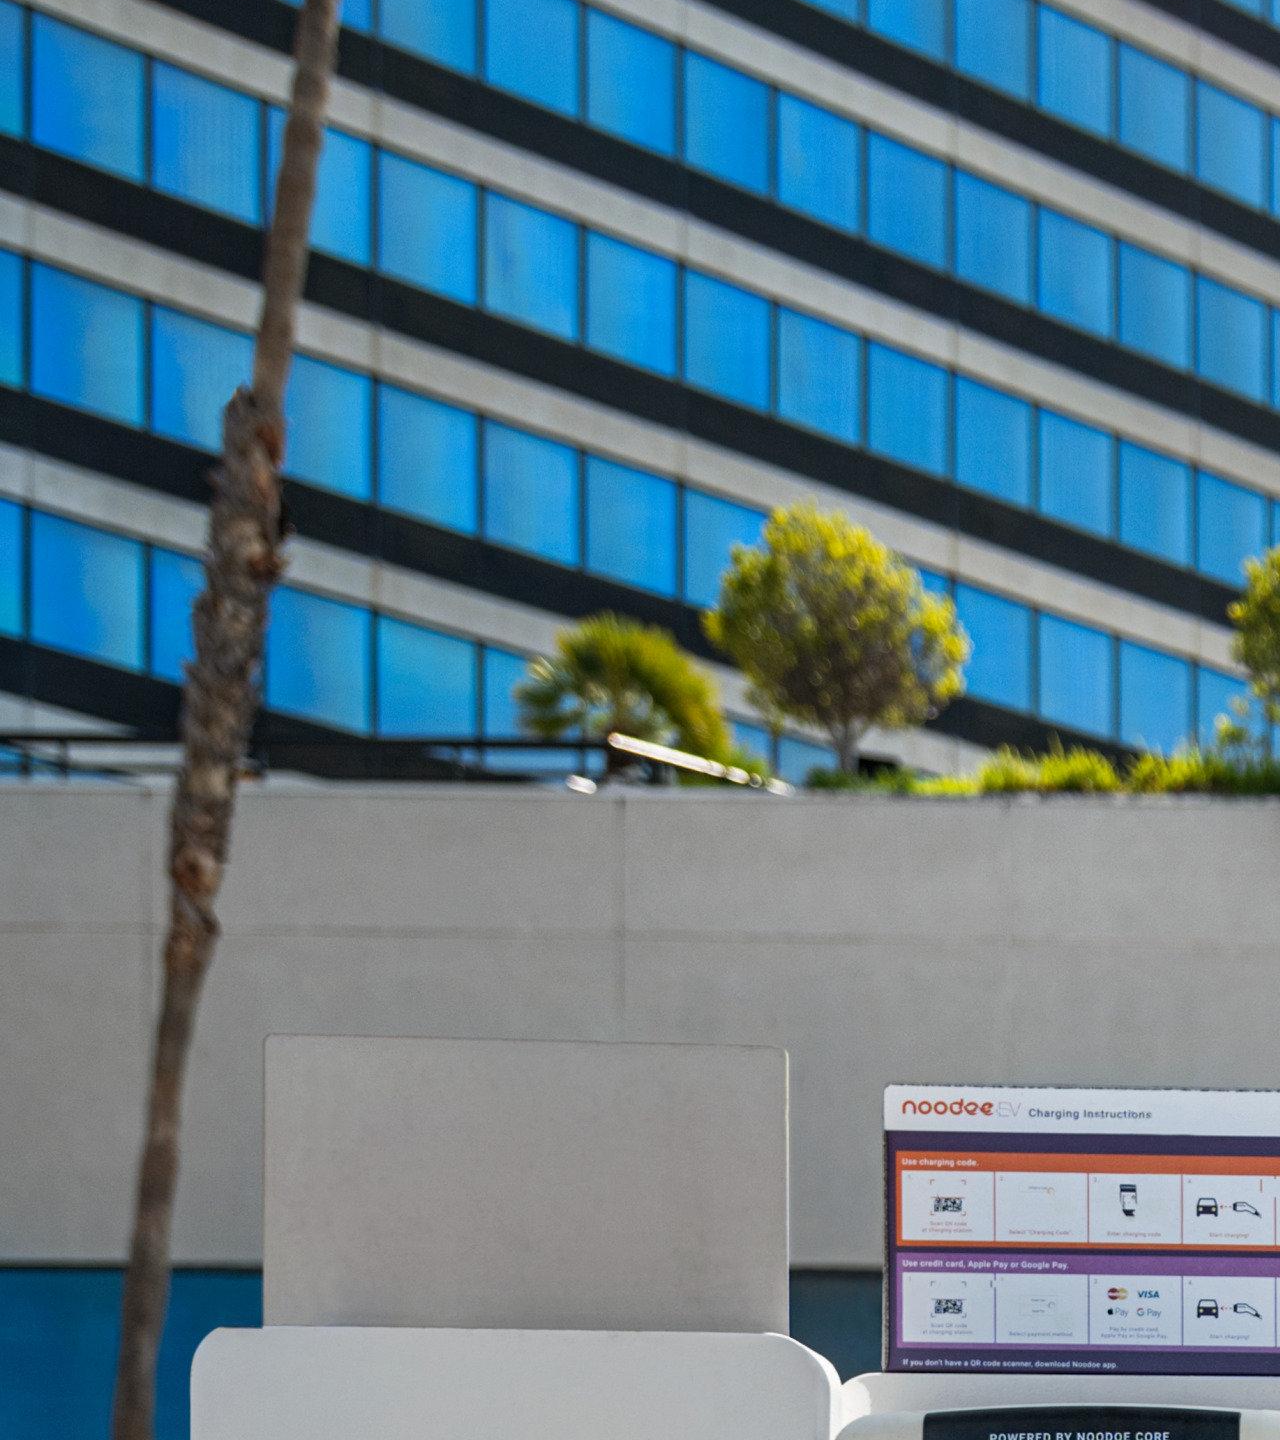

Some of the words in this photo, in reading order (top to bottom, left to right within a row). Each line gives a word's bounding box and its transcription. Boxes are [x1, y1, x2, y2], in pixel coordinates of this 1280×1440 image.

[1028, 1108, 1080, 1120] Charging
[1083, 1109, 1152, 1119] Instructions
[902, 1158, 918, 1166] Use
[919, 1158, 955, 1167] charging
[945, 1260, 966, 1268] card,
[968, 1261, 991, 1269] Apple
[993, 1261, 1008, 1270] Pay
[1021, 1261, 1050, 1270] Google
[1137, 1290, 1160, 1298] VISA
[1115, 1307, 1128, 1318] Pay
[1137, 1308, 1144, 1316] G
[1147, 1308, 1161, 1318] Pay
[1002, 1360, 1033, 1368] scanner,
